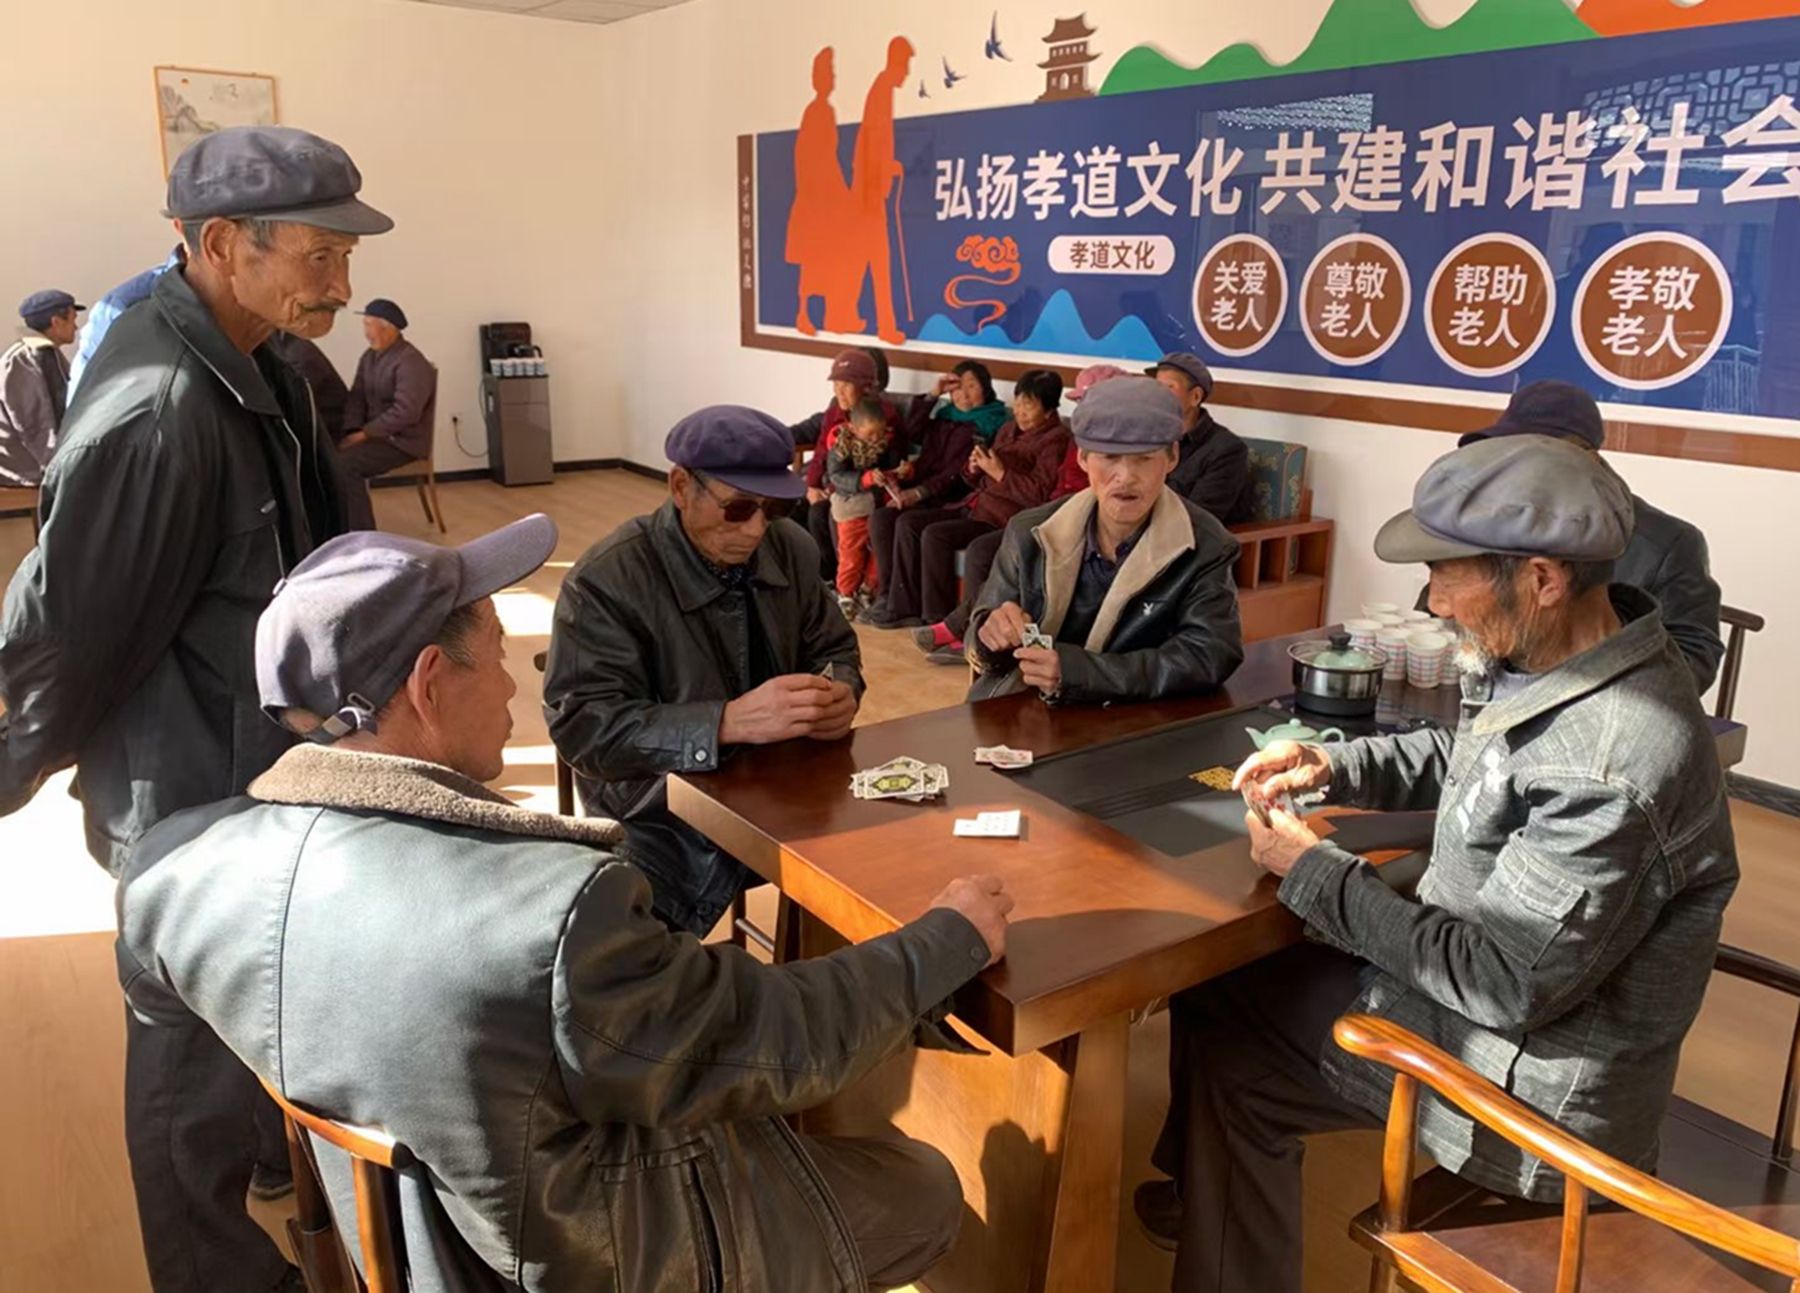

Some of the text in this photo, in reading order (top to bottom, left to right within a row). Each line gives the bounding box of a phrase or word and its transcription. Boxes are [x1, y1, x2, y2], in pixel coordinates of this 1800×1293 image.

[935, 94, 1800, 221] 弘扬孝道文化 共建和谐社会
[1070, 240, 1155, 270] 孝道文化
[1213, 260, 1267, 296] 关爱
[1324, 262, 1388, 300] 尊敬
[1454, 263, 1528, 306] 帮助
[1608, 266, 1700, 311] 孝敬
[1210, 297, 1263, 332] 老人
[1320, 301, 1381, 339] 老人
[1448, 307, 1520, 349] 老人
[1601, 313, 1687, 359] 老人
